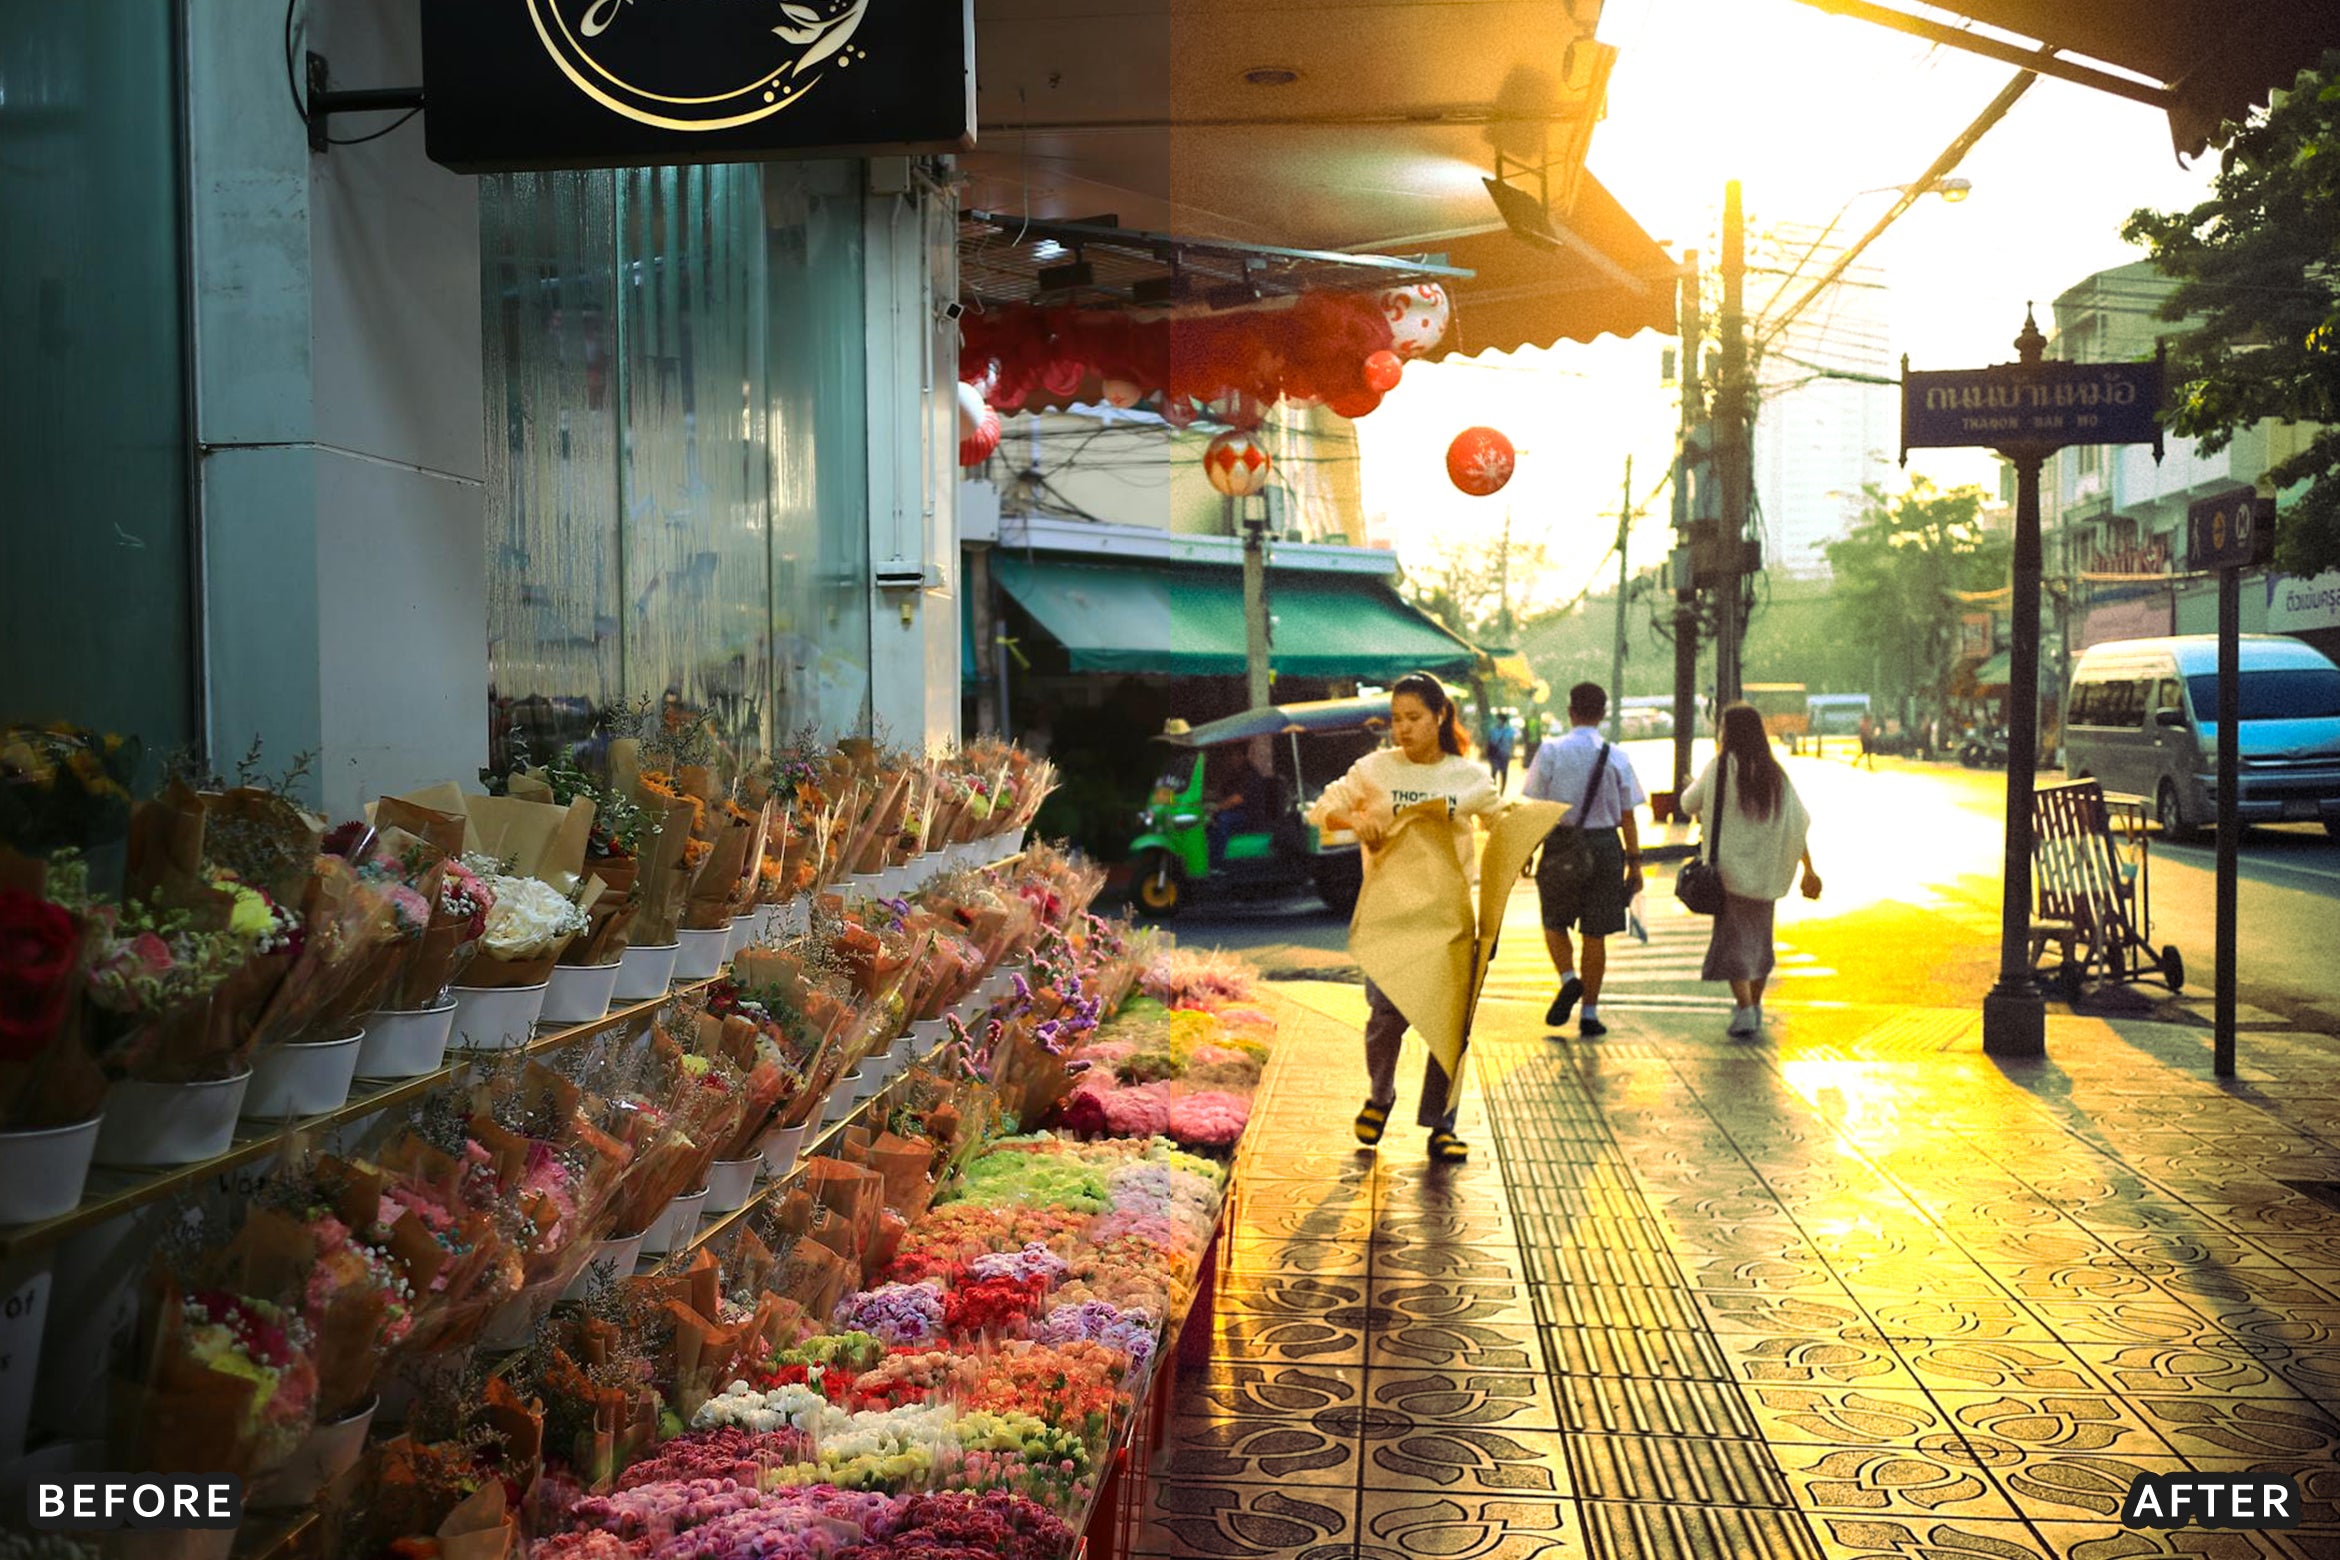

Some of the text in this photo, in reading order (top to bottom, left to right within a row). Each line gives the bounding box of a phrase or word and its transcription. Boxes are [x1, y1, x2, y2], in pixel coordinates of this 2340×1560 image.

[1926, 373, 2136, 410] ถนนบ้านหม้อ
[2033, 415, 2064, 428] BAN
[2077, 414, 2099, 427] MO
